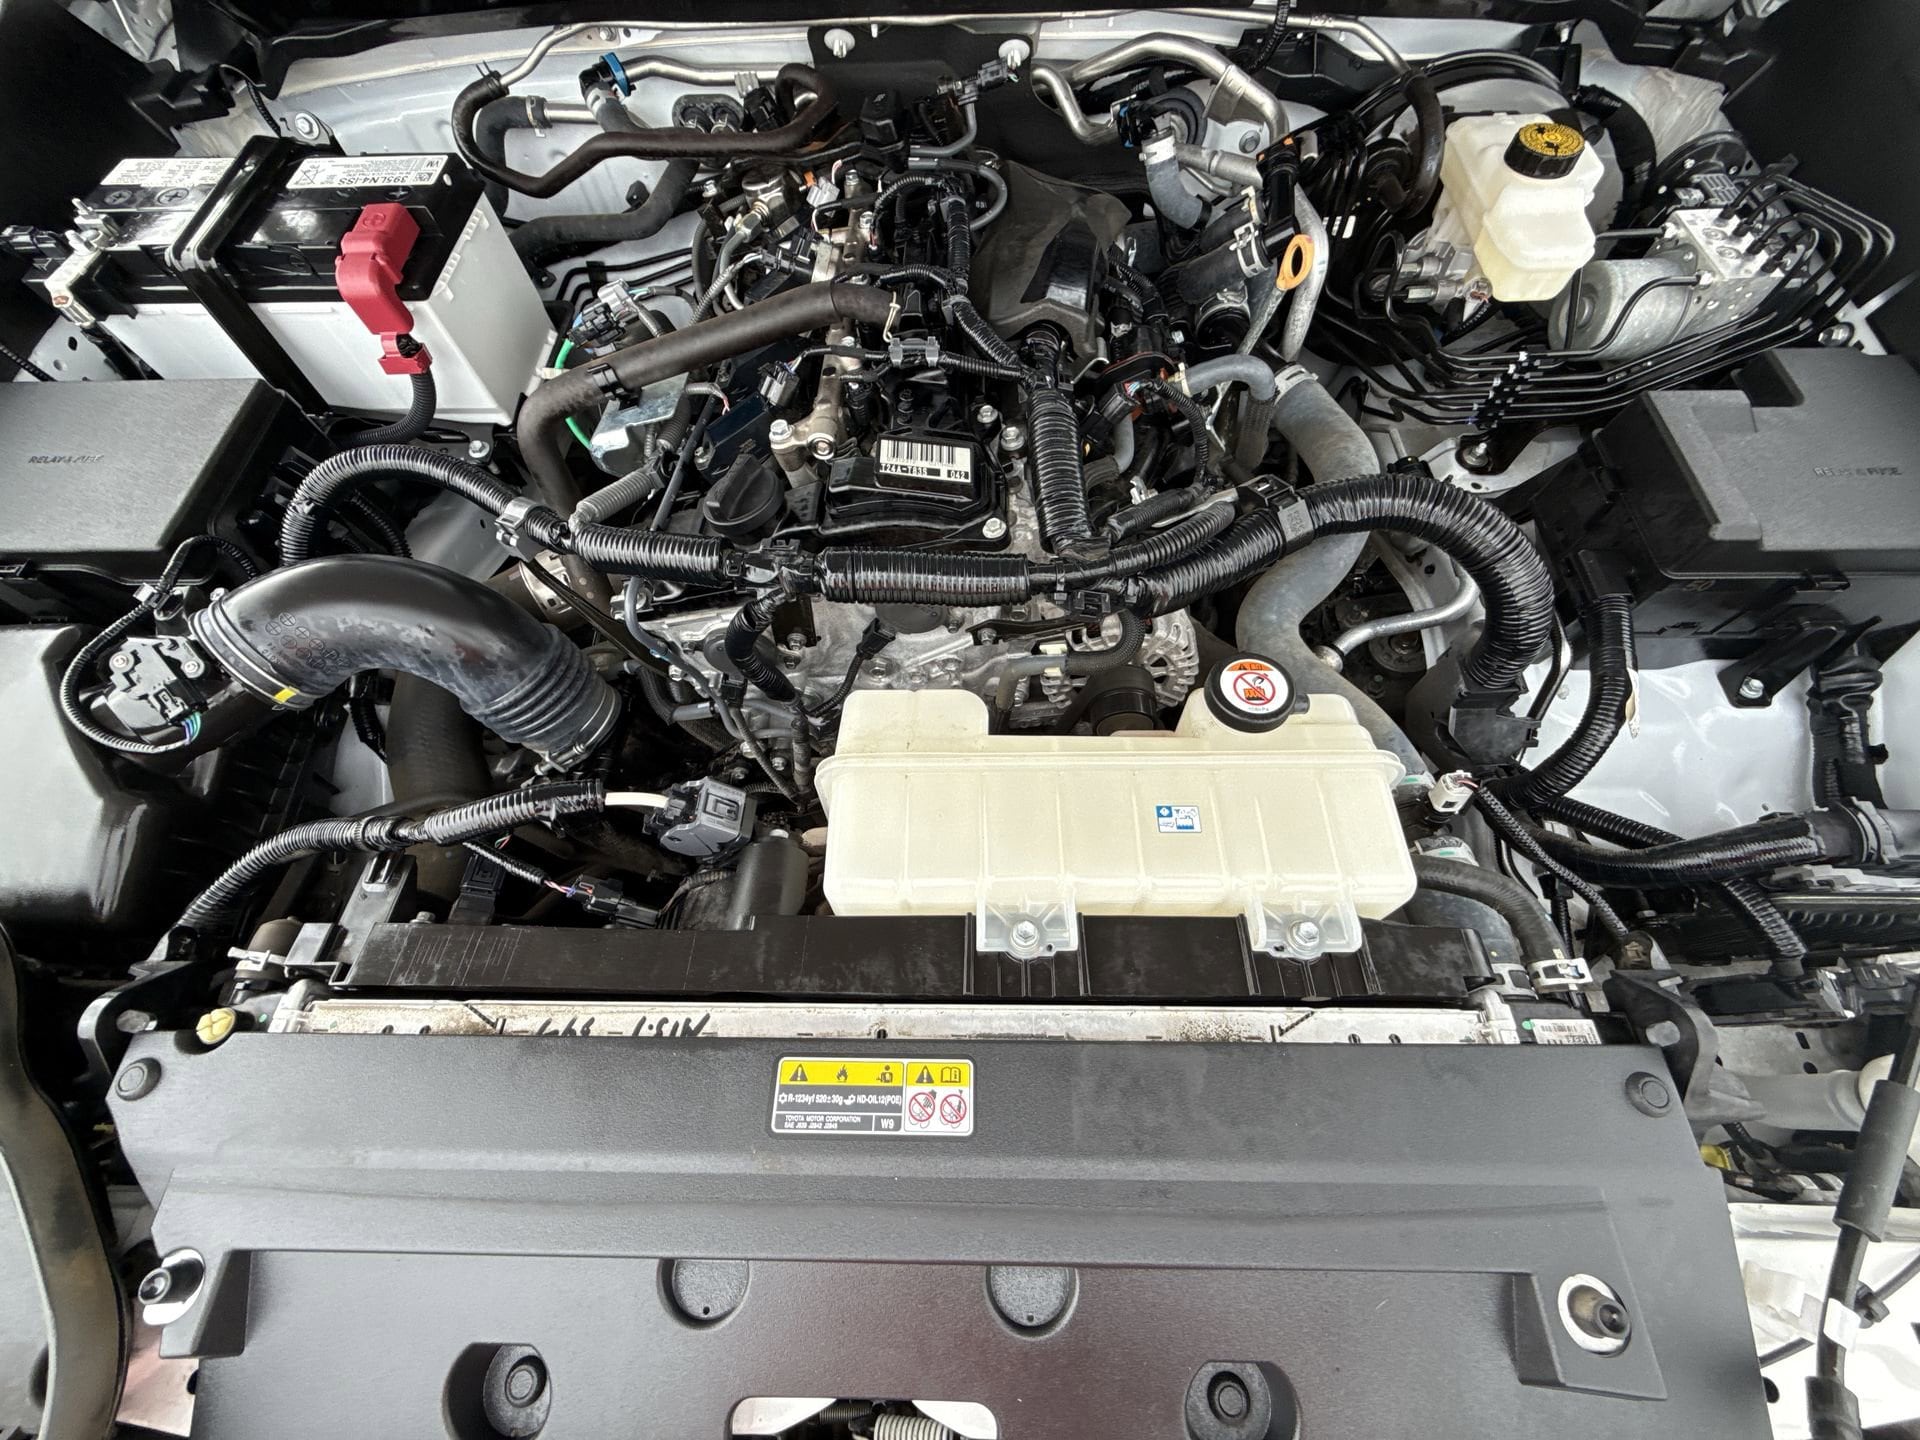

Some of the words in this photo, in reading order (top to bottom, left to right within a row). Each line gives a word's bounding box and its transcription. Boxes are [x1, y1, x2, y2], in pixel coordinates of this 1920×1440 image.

[337, 175, 409, 187] 395LN4-ISS
[785, 1114, 805, 1122] TOYOTA
[825, 1115, 861, 1123] CORPORATION
[881, 1118, 895, 1129] W9
